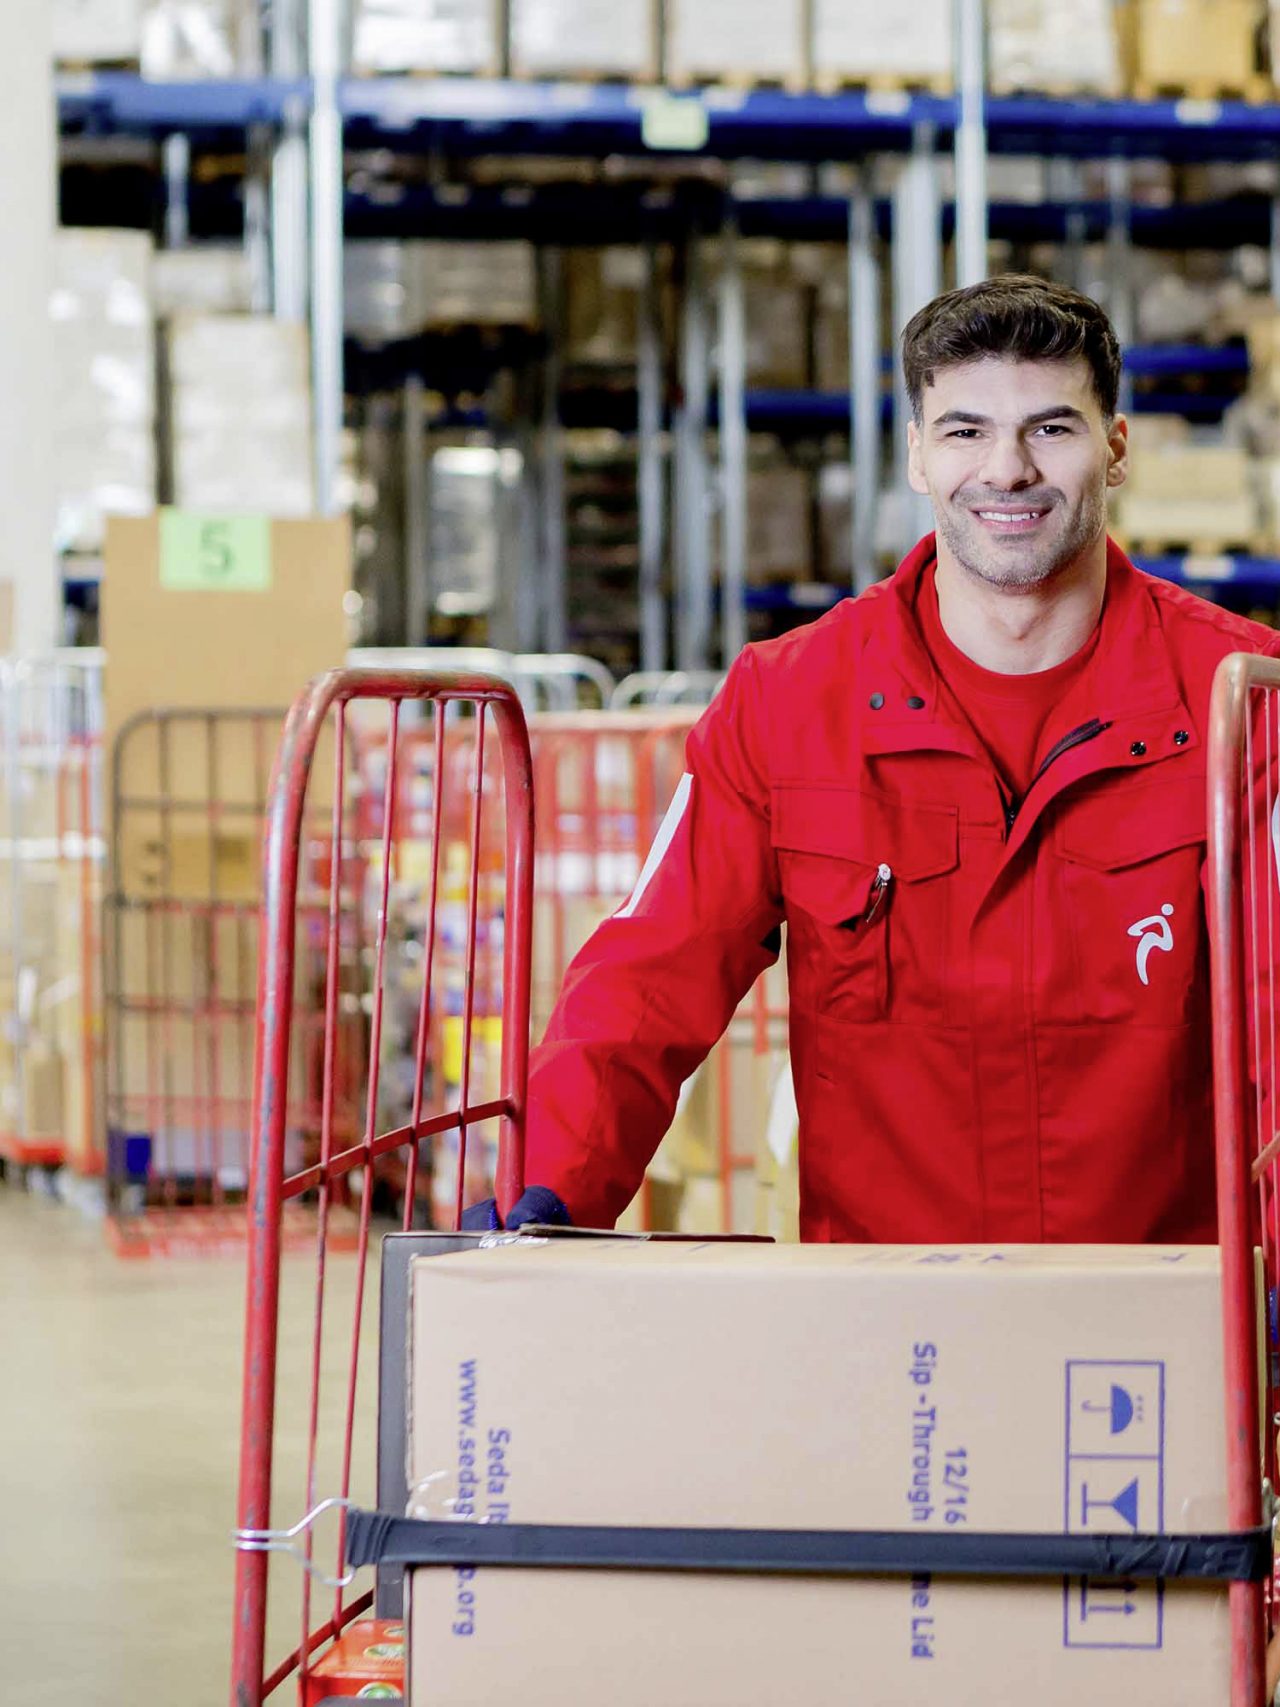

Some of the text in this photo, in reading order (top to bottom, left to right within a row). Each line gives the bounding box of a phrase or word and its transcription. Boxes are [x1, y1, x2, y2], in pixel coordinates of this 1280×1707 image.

[200, 519, 237, 579] 5
[908, 1342, 937, 1386] Sip
[487, 1427, 510, 1494] Seda
[943, 1447, 970, 1525] 12/16
[453, 1359, 479, 1637] www.sedagp.org
[911, 1617, 934, 1659] Lid
